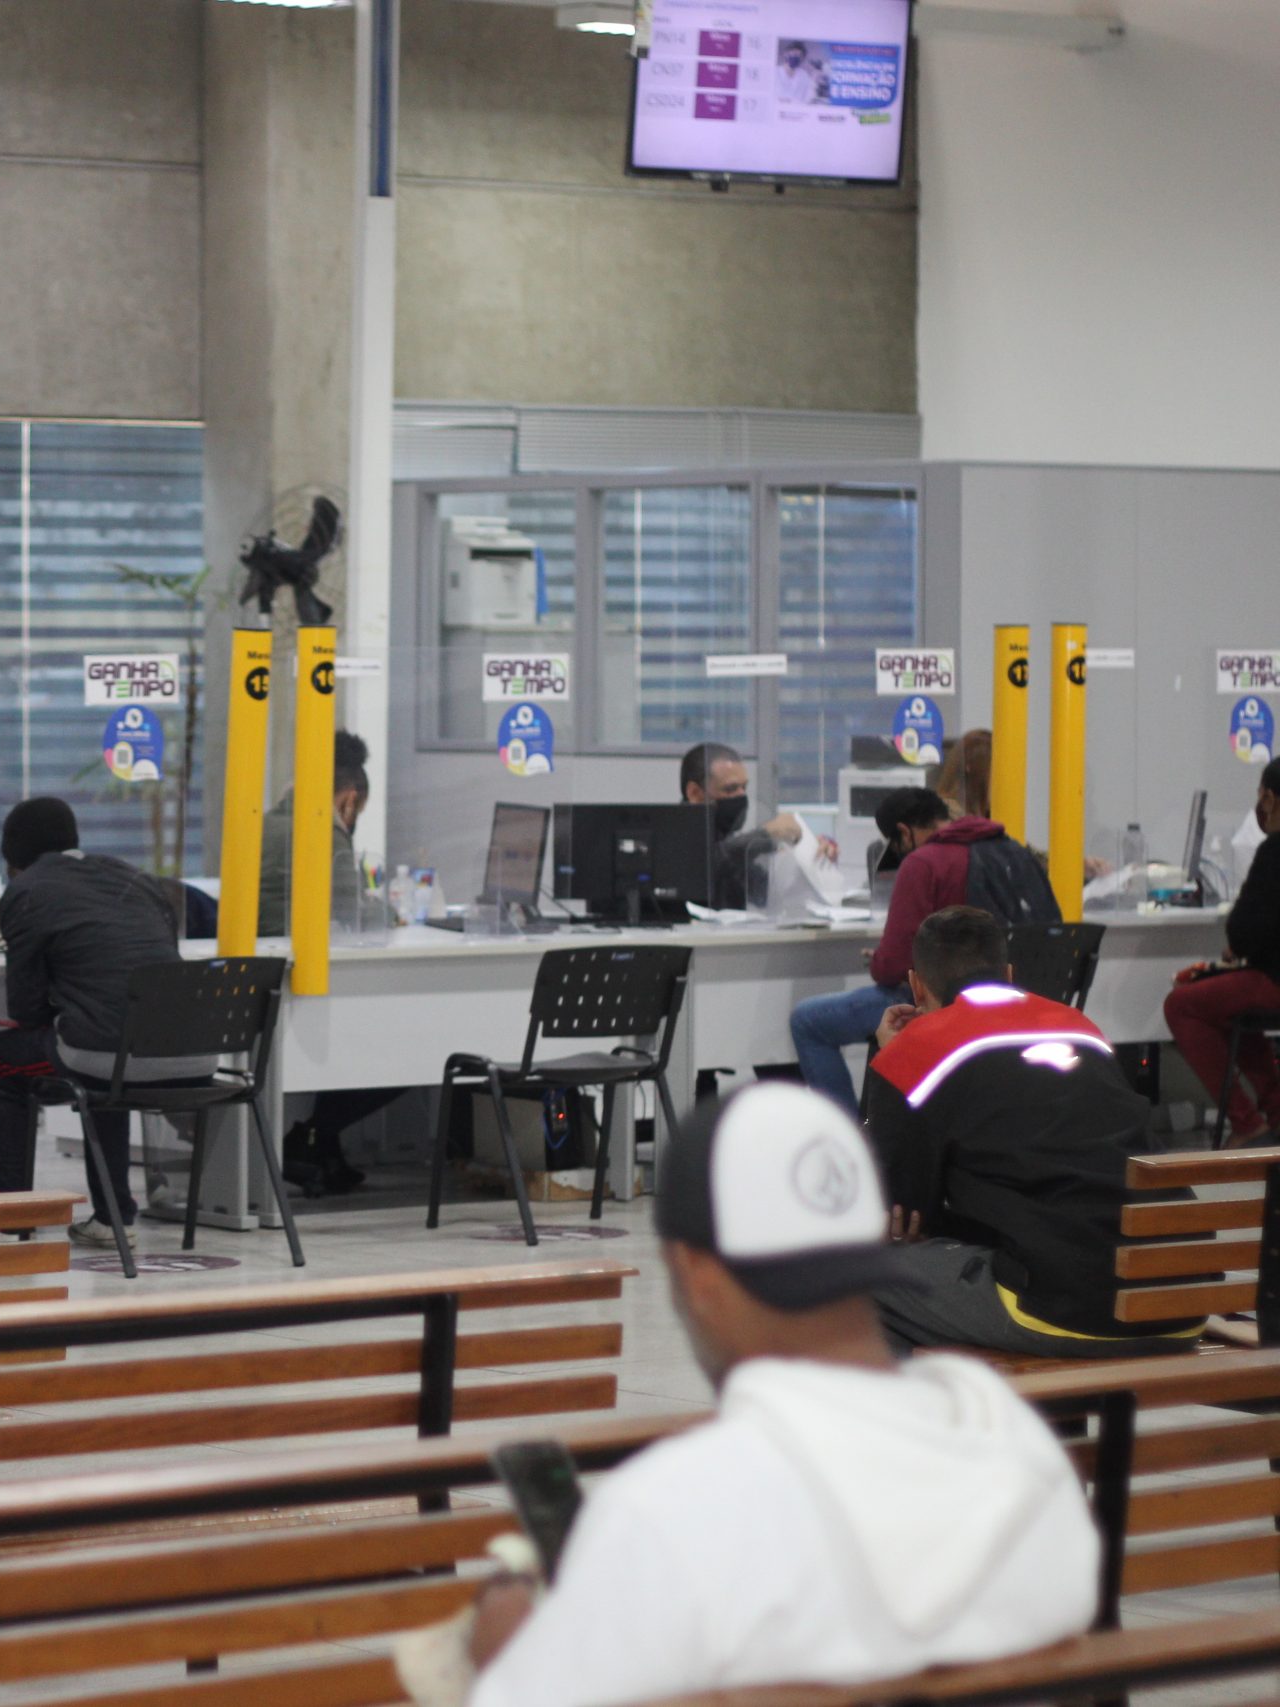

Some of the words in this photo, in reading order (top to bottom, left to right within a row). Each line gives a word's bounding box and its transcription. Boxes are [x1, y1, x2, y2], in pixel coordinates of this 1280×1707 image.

[88, 661, 159, 680] GANHA
[486, 660, 551, 676] GANHA
[880, 655, 938, 671] GANHA
[501, 677, 566, 694] TEMPO
[893, 671, 952, 688] TEMPO
[104, 680, 175, 698] TEMPO
